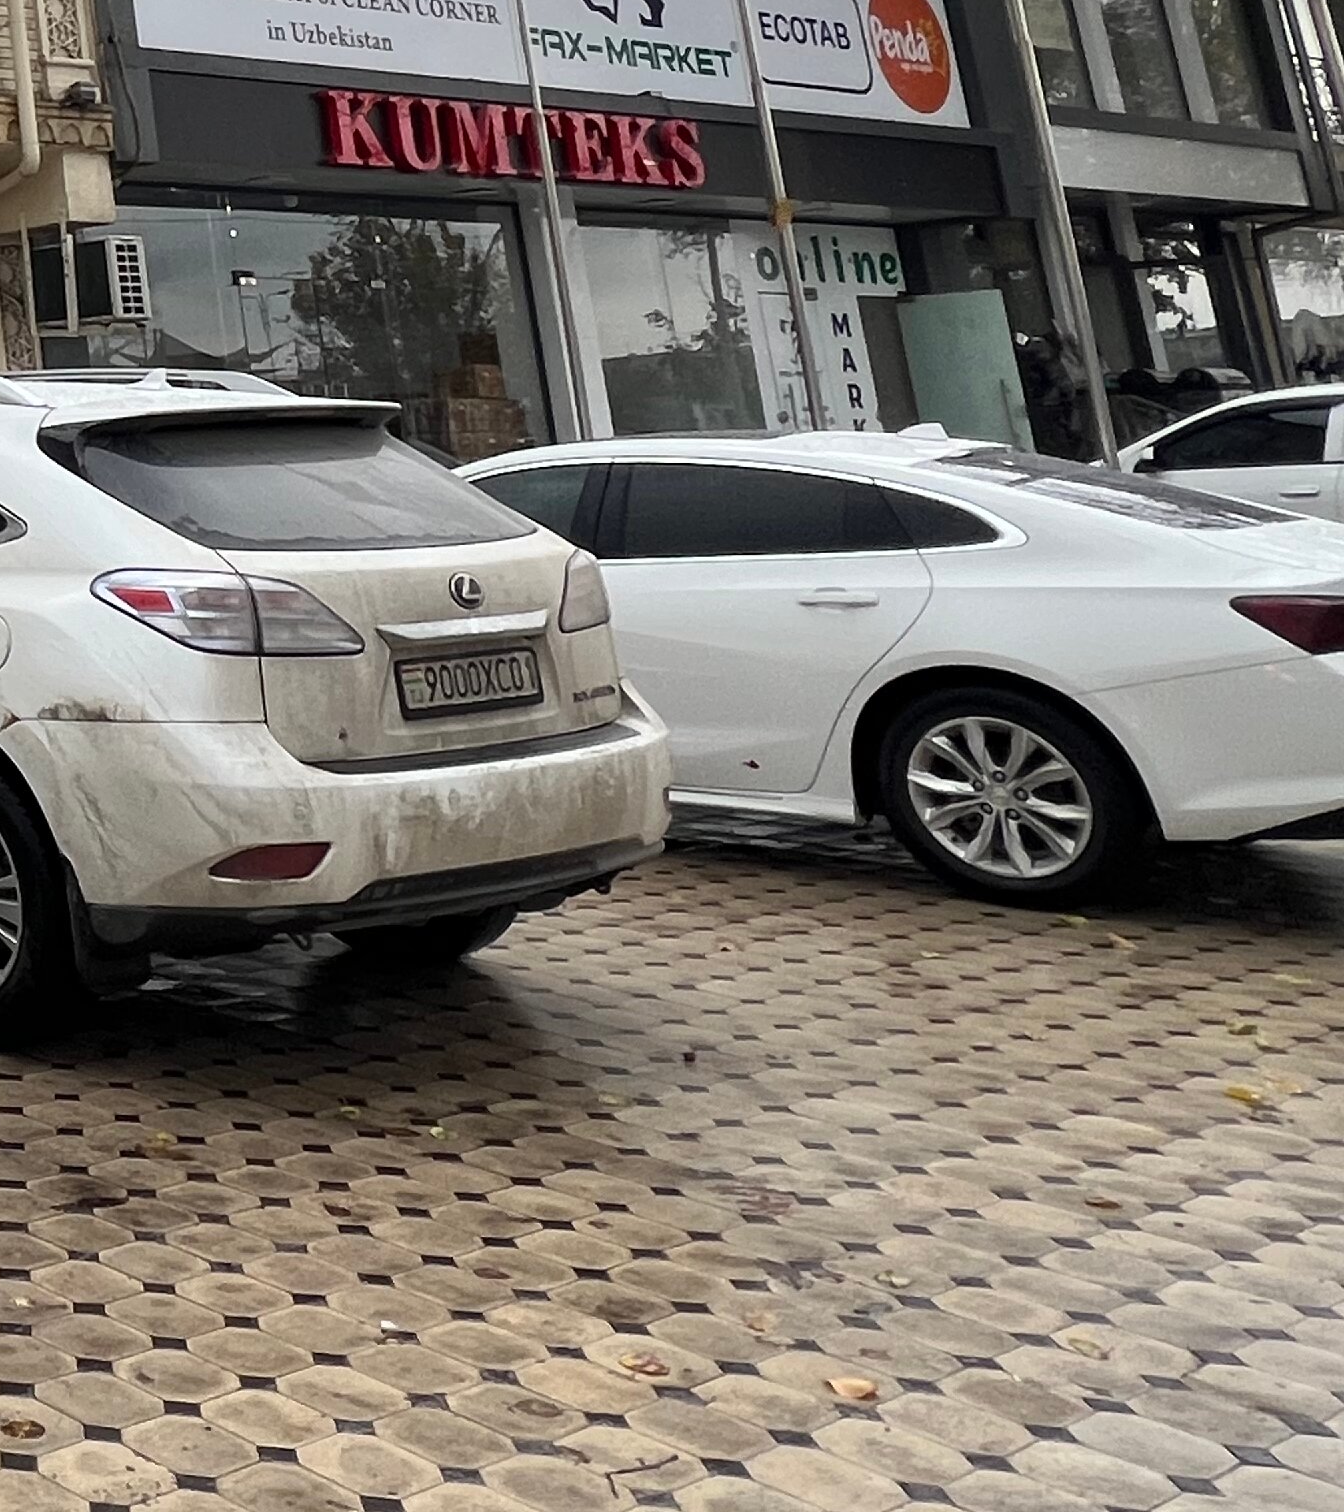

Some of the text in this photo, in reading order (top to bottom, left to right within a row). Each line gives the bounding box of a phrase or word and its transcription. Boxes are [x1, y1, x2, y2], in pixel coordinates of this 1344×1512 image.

[266, 19, 395, 53] in Uzbekistan
[758, 11, 851, 50] ECOTAB
[869, 15, 934, 64] Penda
[318, 89, 706, 188] KUMTEKS
